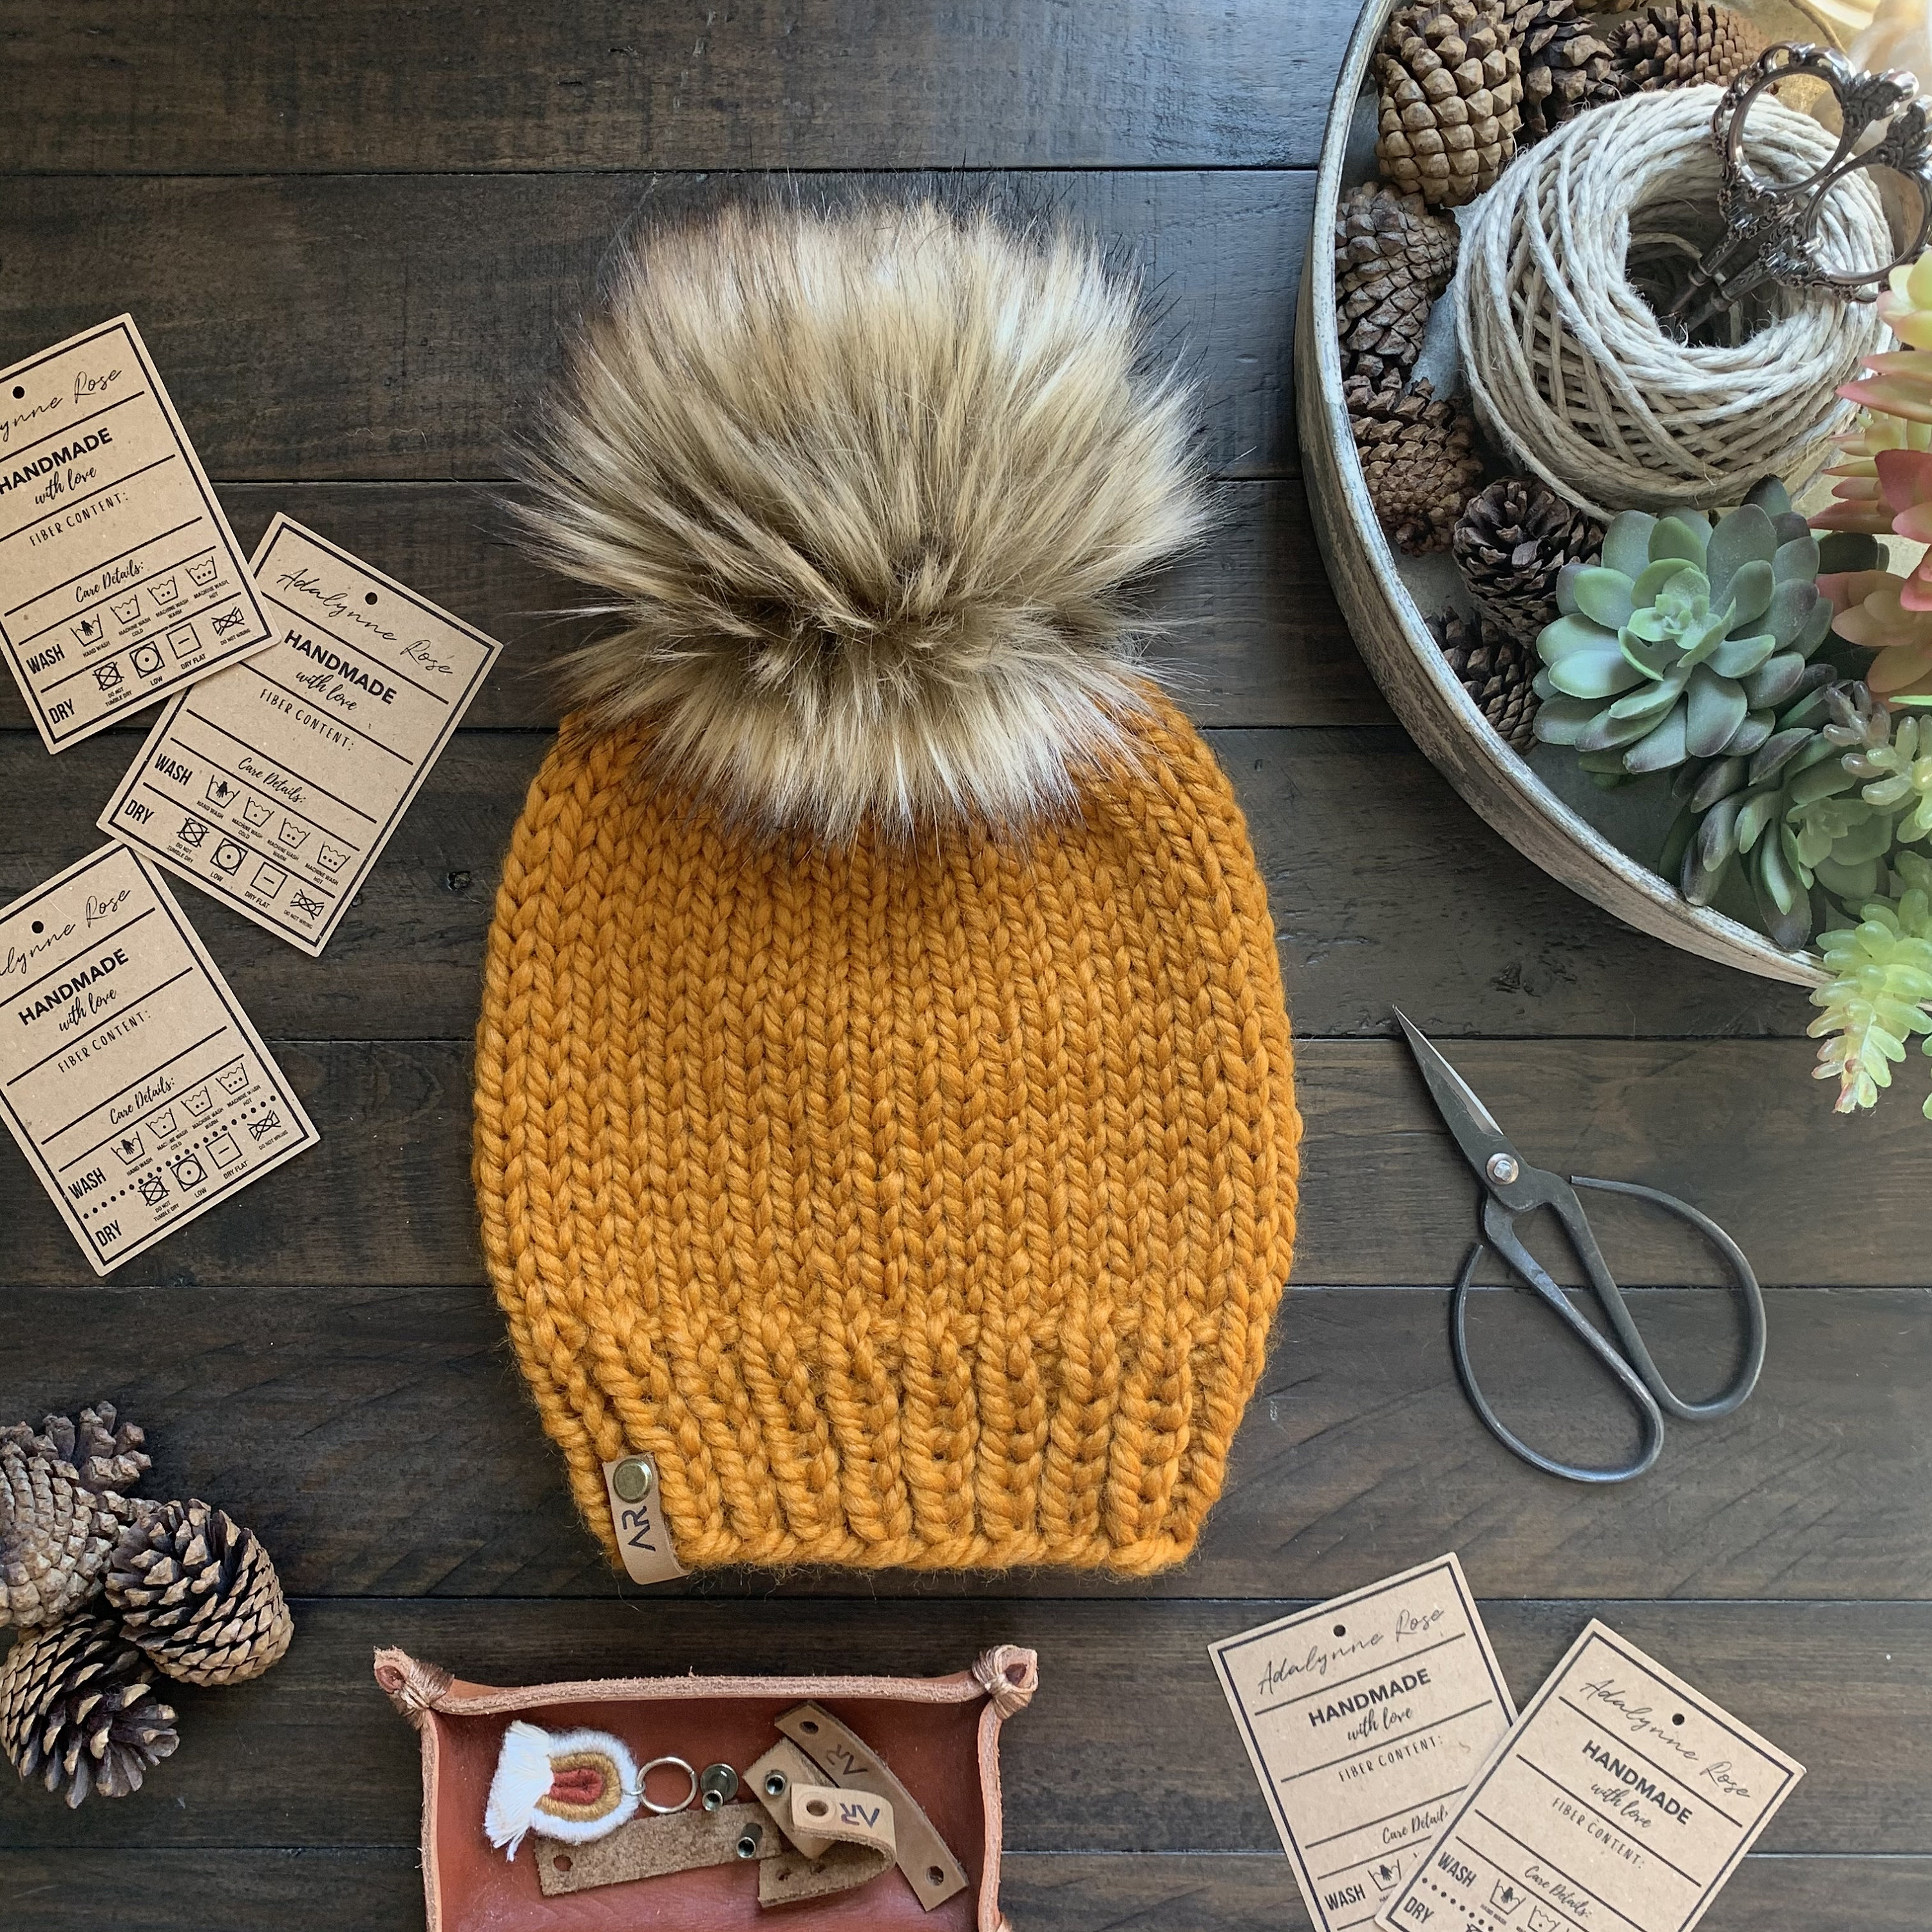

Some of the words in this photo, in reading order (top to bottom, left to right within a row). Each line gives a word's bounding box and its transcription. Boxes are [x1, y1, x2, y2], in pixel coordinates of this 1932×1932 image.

[0, 397, 63, 442] ynne
[74, 370, 122, 404] Rose
[0, 427, 113, 495] HANDMADE
[35, 471, 64, 504] with
[68, 467, 97, 491] love
[30, 522, 63, 546] FIBER
[66, 493, 128, 527] CONTENT:
[76, 584, 100, 603] Care
[102, 559, 144, 590] Details:
[276, 568, 397, 641] Adalynne
[131, 628, 144, 637] COLD
[138, 617, 151, 626] WASH
[26, 643, 65, 674] WASH
[82, 648, 97, 658] HAND
[96, 641, 111, 651] WASH
[180, 660, 192, 670] DRY
[193, 653, 206, 664] FLAT
[150, 676, 163, 686] LOW
[284, 629, 397, 705] HANDMADE
[296, 672, 334, 692] with
[326, 684, 357, 710] love
[48, 698, 75, 724] DRY
[260, 688, 292, 714] FIBER
[296, 710, 354, 751] CONTENT:
[155, 753, 193, 786] WASH
[238, 757, 263, 778] Care
[263, 772, 307, 803] Details:
[124, 799, 155, 825] DRY
[196, 800, 211, 811] HAND
[210, 808, 224, 819] WASH
[210, 871, 223, 882] LOW
[305, 863, 326, 878] MACHINE
[325, 875, 339, 886] WASH
[244, 891, 257, 900] DRY
[256, 898, 270, 909] FLAT
[0, 923, 76, 978] lynne
[86, 890, 131, 929] Rose
[299, 919, 313, 929] WRING
[18, 948, 129, 1026] HANDMADE
[59, 996, 87, 1032] with
[88, 989, 117, 1014] love
[58, 1047, 90, 1073] FIBER
[92, 1010, 151, 1050] CONTENT:
[110, 1104, 133, 1124] Care
[135, 1076, 175, 1110] Details:
[227, 1092, 247, 1108] MACHINE
[243, 1098, 252, 1106] HOT
[68, 1167, 107, 1199] WASH
[126, 1166, 140, 1176] HAND
[139, 1157, 153, 1168] WASH
[223, 1169, 234, 1179] DRY
[234, 1160, 248, 1172] FLAT
[170, 1203, 179, 1211] DRY
[194, 1187, 207, 1198] LOW
[95, 1219, 122, 1247] DRY
[1258, 1634, 1384, 1696] Adalynne
[1396, 1609, 1444, 1643] Rose
[1308, 1668, 1431, 1727] HANDMADE
[1347, 1708, 1379, 1741] with
[1383, 1707, 1412, 1730] love
[1579, 1679, 1698, 1761] Adalynne
[1699, 1761, 1750, 1798] Rose
[1338, 1760, 1374, 1782] FIBER
[1378, 1736, 1443, 1766] CONTENT:
[1582, 1739, 1693, 1825] HANDMADE
[1591, 1783, 1630, 1807] with
[1620, 1800, 1651, 1828] love
[1383, 1826, 1408, 1844] Care
[1552, 1797, 1586, 1826] FIBER
[1587, 1822, 1644, 1869] CONTENT:
[1437, 1852, 1477, 1888] WASH
[1324, 1884, 1366, 1911] WASH
[1524, 1866, 1550, 1888] Care
[1549, 1884, 1592, 1918] Details:
[1403, 1896, 1434, 1924] DRY
